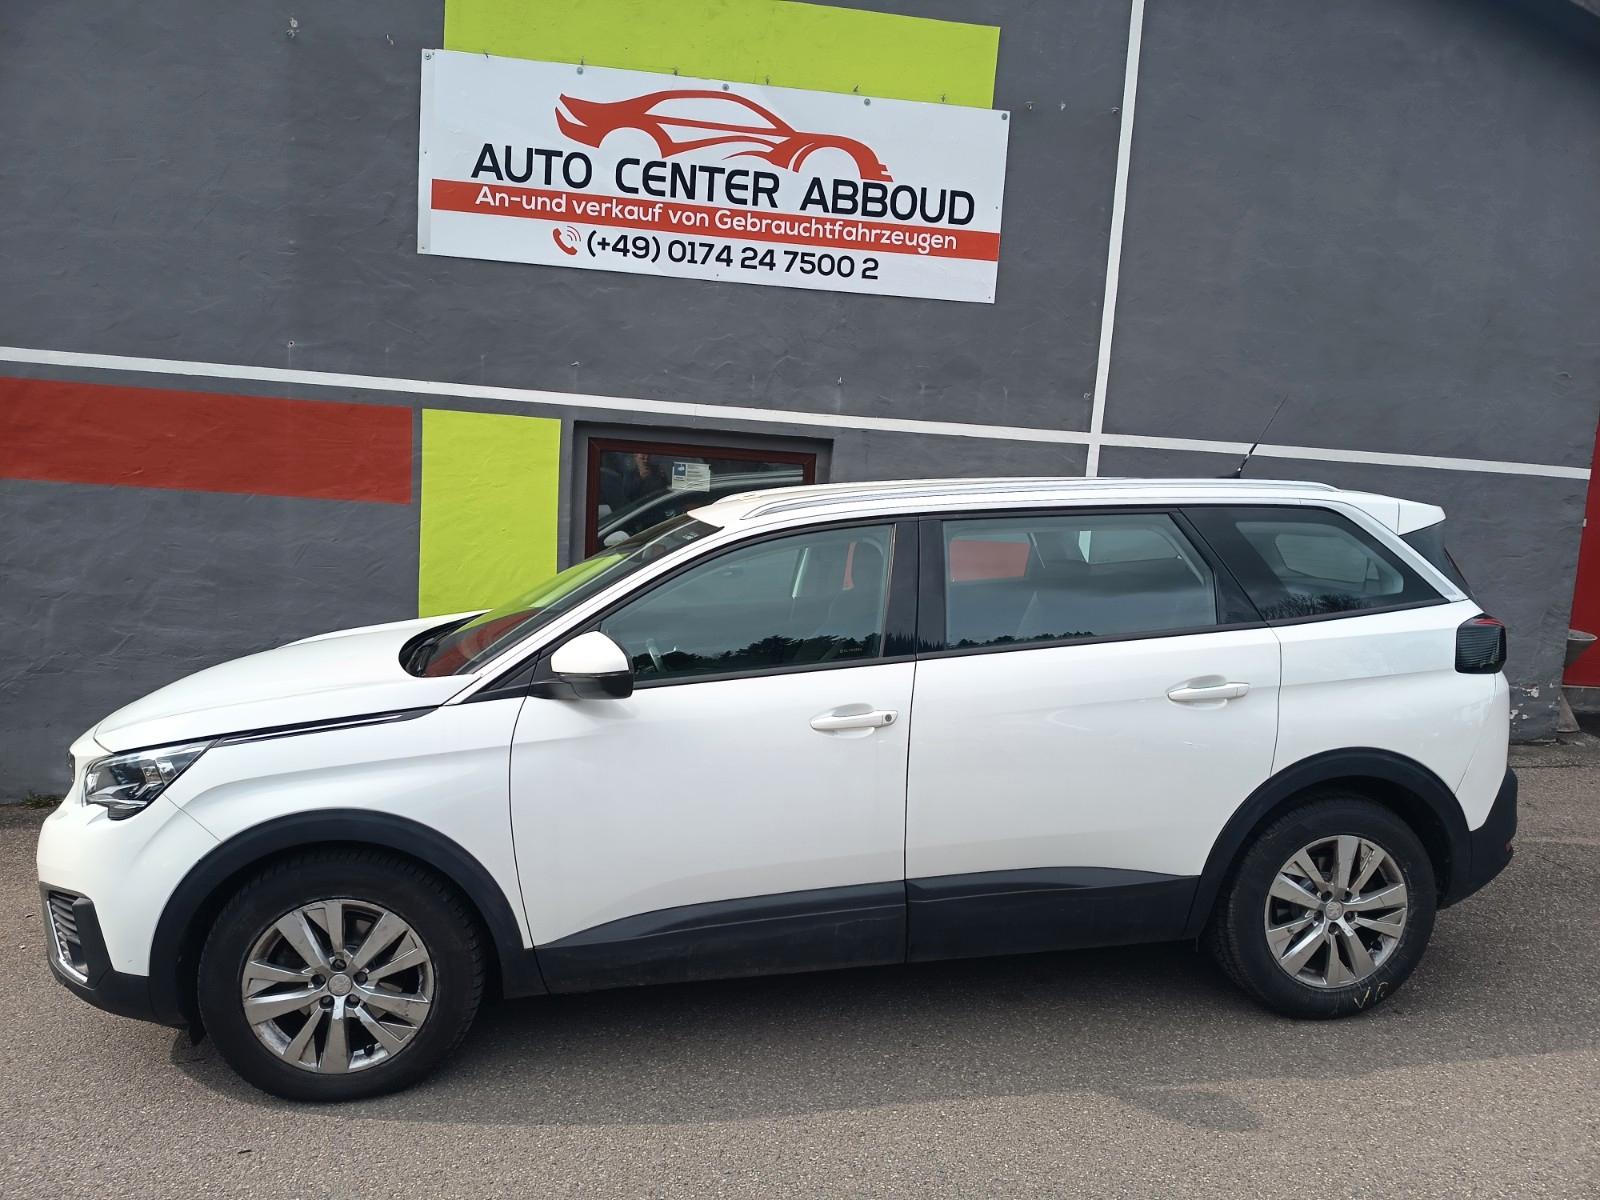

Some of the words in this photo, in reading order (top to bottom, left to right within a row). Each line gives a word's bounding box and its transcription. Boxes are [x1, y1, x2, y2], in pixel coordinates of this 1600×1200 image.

[471, 144, 593, 188] AUTO
[616, 158, 780, 209] CENTER
[800, 177, 975, 226] ABBOUD
[475, 185, 567, 213] An-und
[572, 200, 664, 224] verkauf
[668, 209, 709, 227] von
[714, 209, 958, 255] Gebrauchtfahrzeugen
[588, 230, 661, 263] (+49)
[668, 239, 734, 268] 0174
[740, 246, 776, 270] 24
